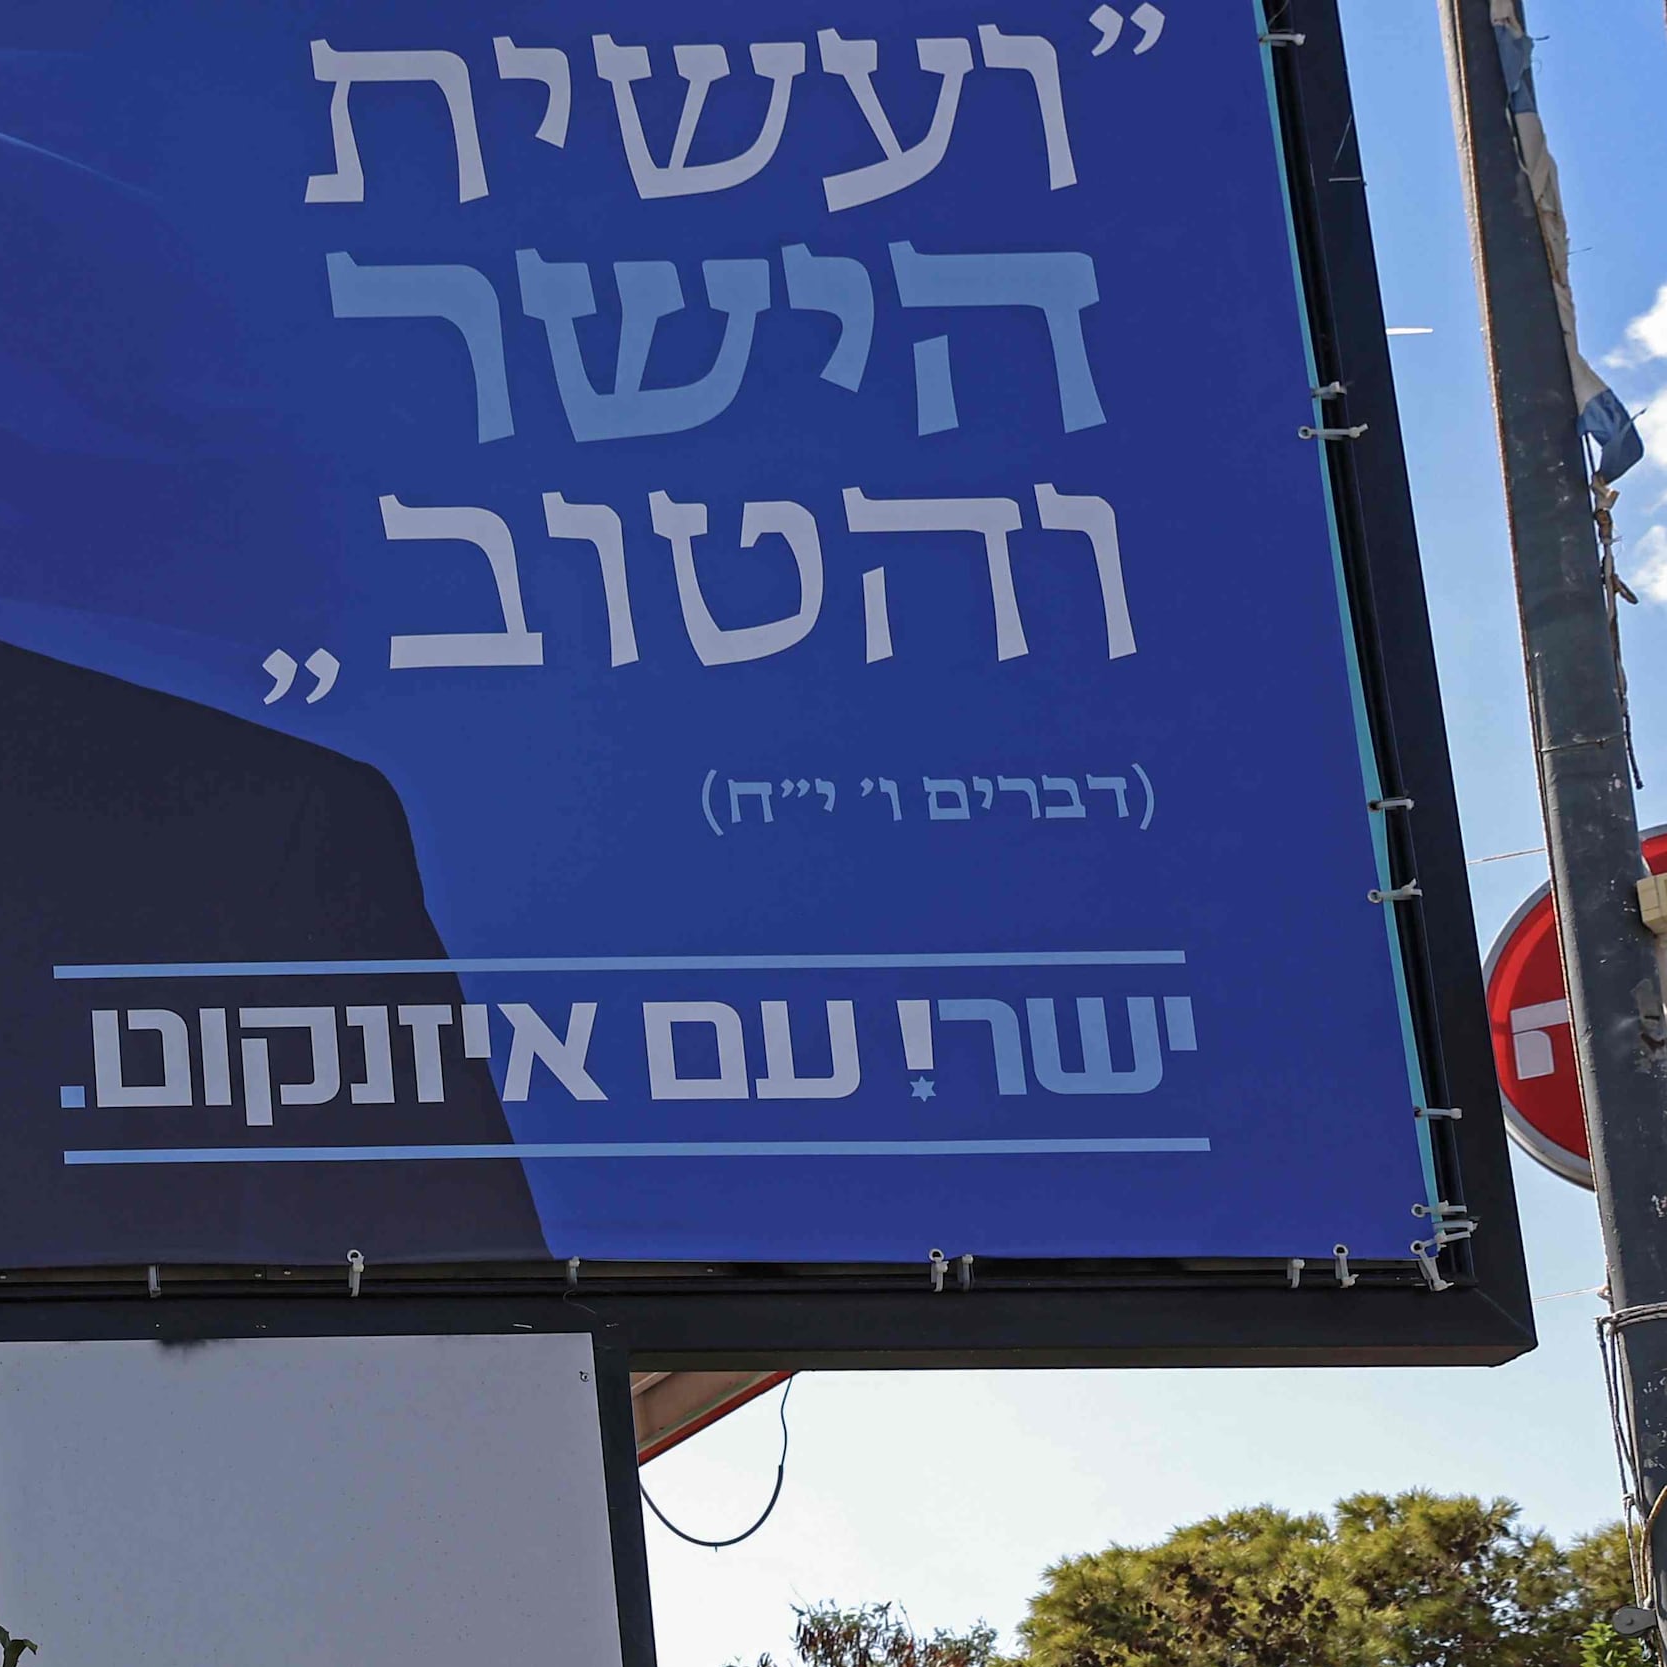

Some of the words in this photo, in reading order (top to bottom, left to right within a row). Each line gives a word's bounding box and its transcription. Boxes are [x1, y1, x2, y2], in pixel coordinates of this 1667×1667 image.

[324, 240, 1107, 444] הישר
[921, 762, 1155, 832] (דברים
[60, 1001, 608, 1126] איזנקוט.
[641, 999, 861, 1102] עם
[885, 995, 1198, 1103] ישר!
